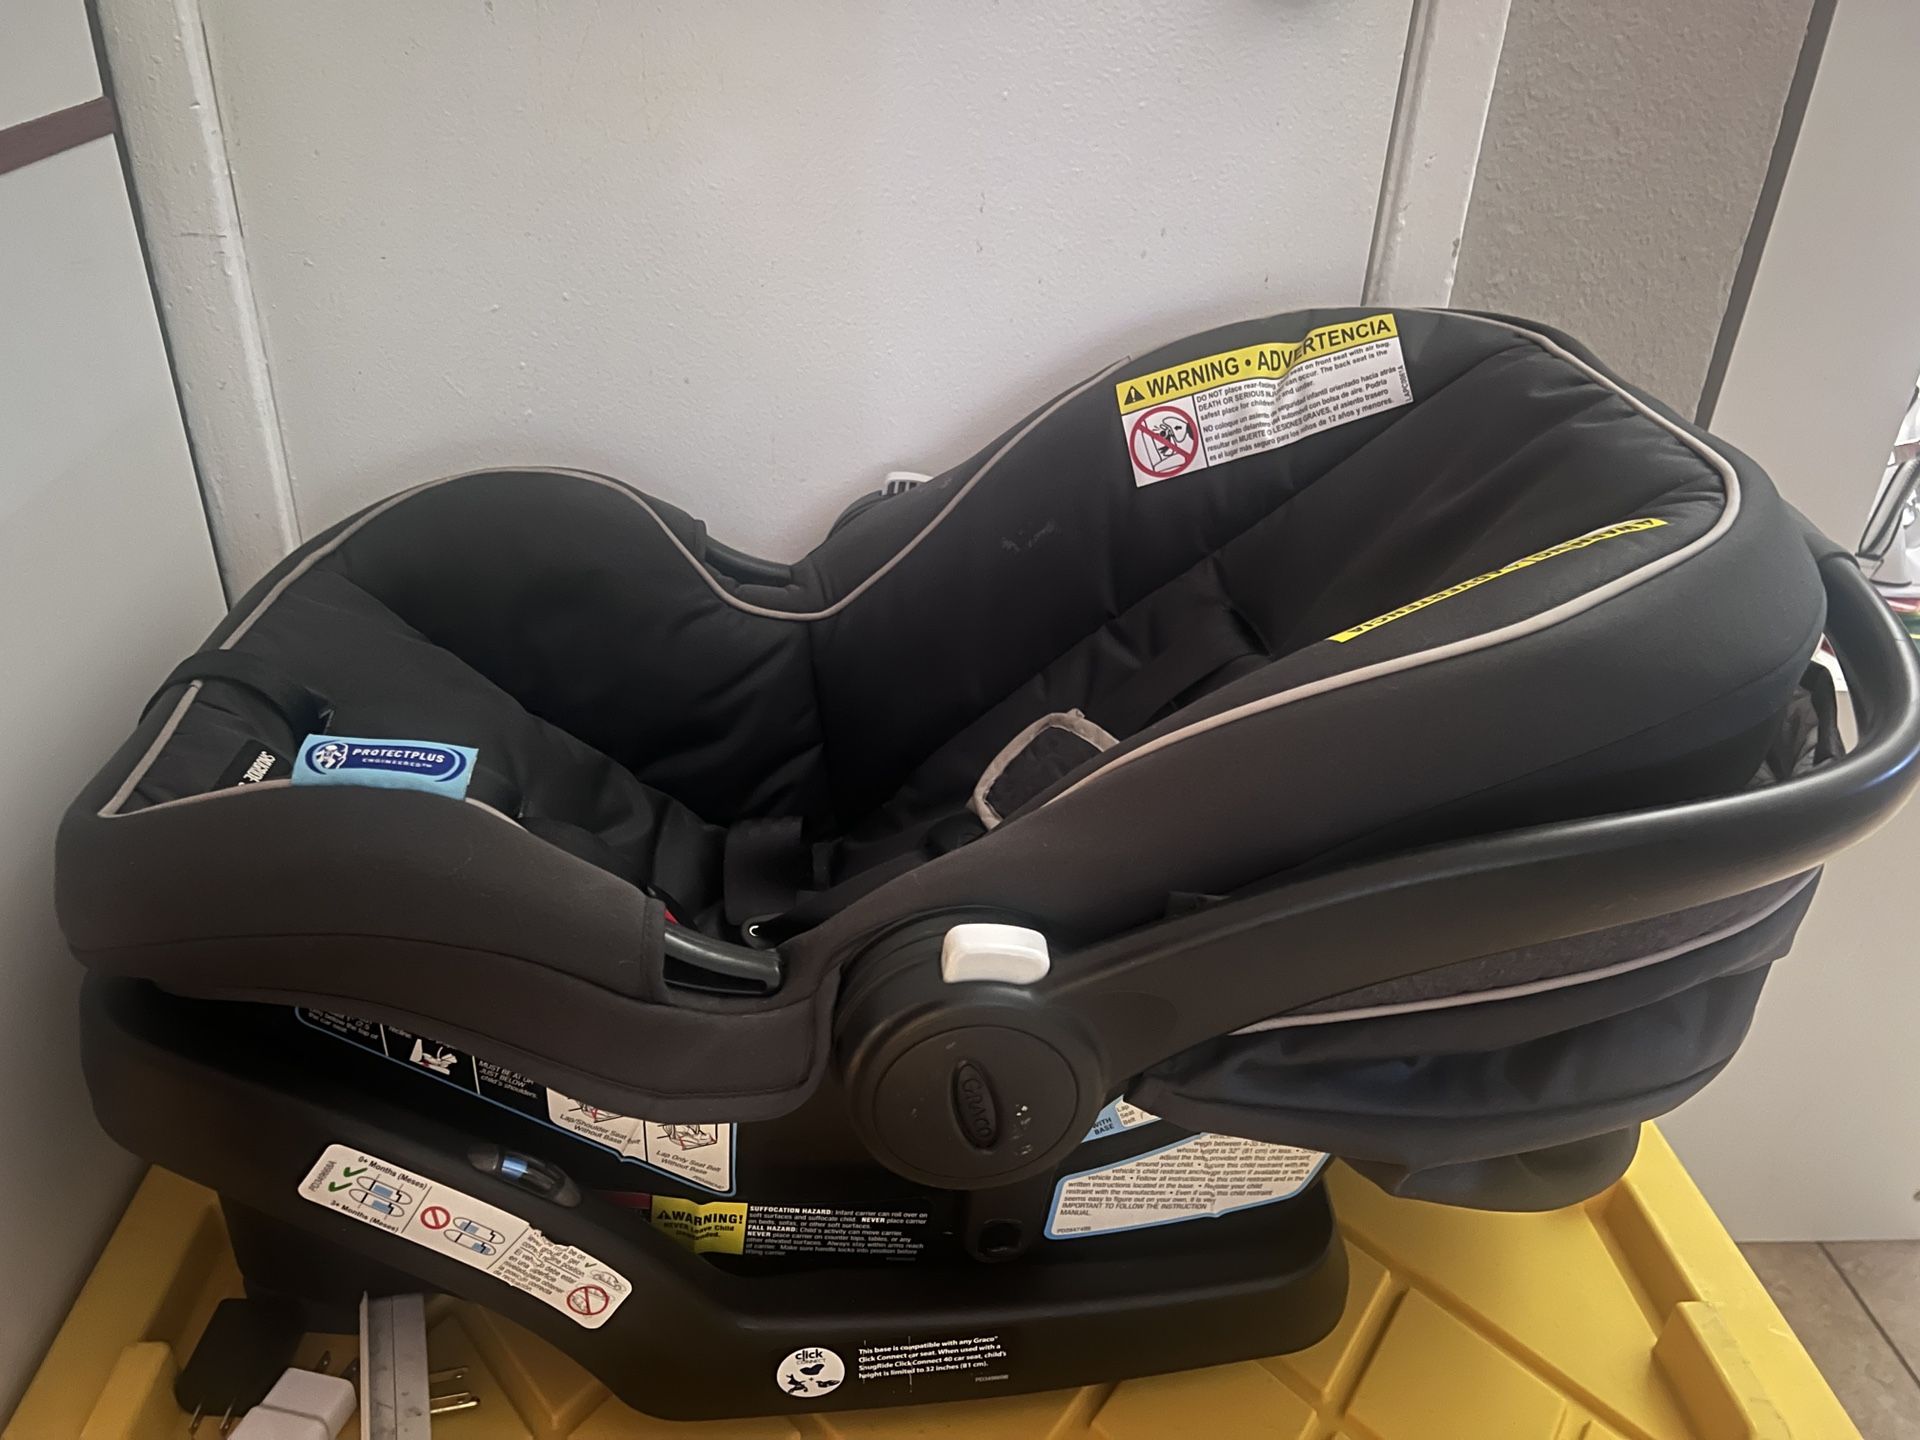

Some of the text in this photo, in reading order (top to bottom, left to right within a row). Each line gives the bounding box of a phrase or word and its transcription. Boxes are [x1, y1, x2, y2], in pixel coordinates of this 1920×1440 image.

[1146, 319, 1391, 399] WARNING ADVERTENCIA
[1196, 394, 1206, 402] DO
[1208, 389, 1221, 398] NOT
[1315, 357, 1331, 366] front
[1333, 352, 1347, 360] seat
[1198, 399, 1221, 411] DEATH
[1223, 396, 1233, 404] OR
[1234, 390, 1263, 401] SERIOUS
[1334, 360, 1349, 369] back
[352, 748, 446, 764] PROTECTPLUS
[499, 1075, 525, 1087] BELOW
[559, 1113, 608, 1133] Lap/Shoulder
[610, 1130, 626, 1139] Seat
[1093, 1117, 1111, 1130] WITH
[1094, 1123, 1114, 1136] BASE
[574, 1124, 621, 1143] Without Base
[661, 1158, 707, 1174] Without Base
[671, 1154, 687, 1163] Only
[689, 1159, 705, 1167] Seat
[369, 1160, 396, 1176] Months
[397, 1173, 427, 1189] (Meses)
[750, 1205, 800, 1213] SUFFOCATION
[1062, 1201, 1102, 1209] IMPORTANT
[1161, 1202, 1206, 1210] INSTRUCTION
[341, 1204, 367, 1219] Months
[369, 1216, 398, 1232] (Meses)
[671, 1210, 742, 1227] WARNING!
[900, 1342, 939, 1350] compatible
[794, 1349, 822, 1361] click
[859, 1362, 892, 1370] SnugRide
